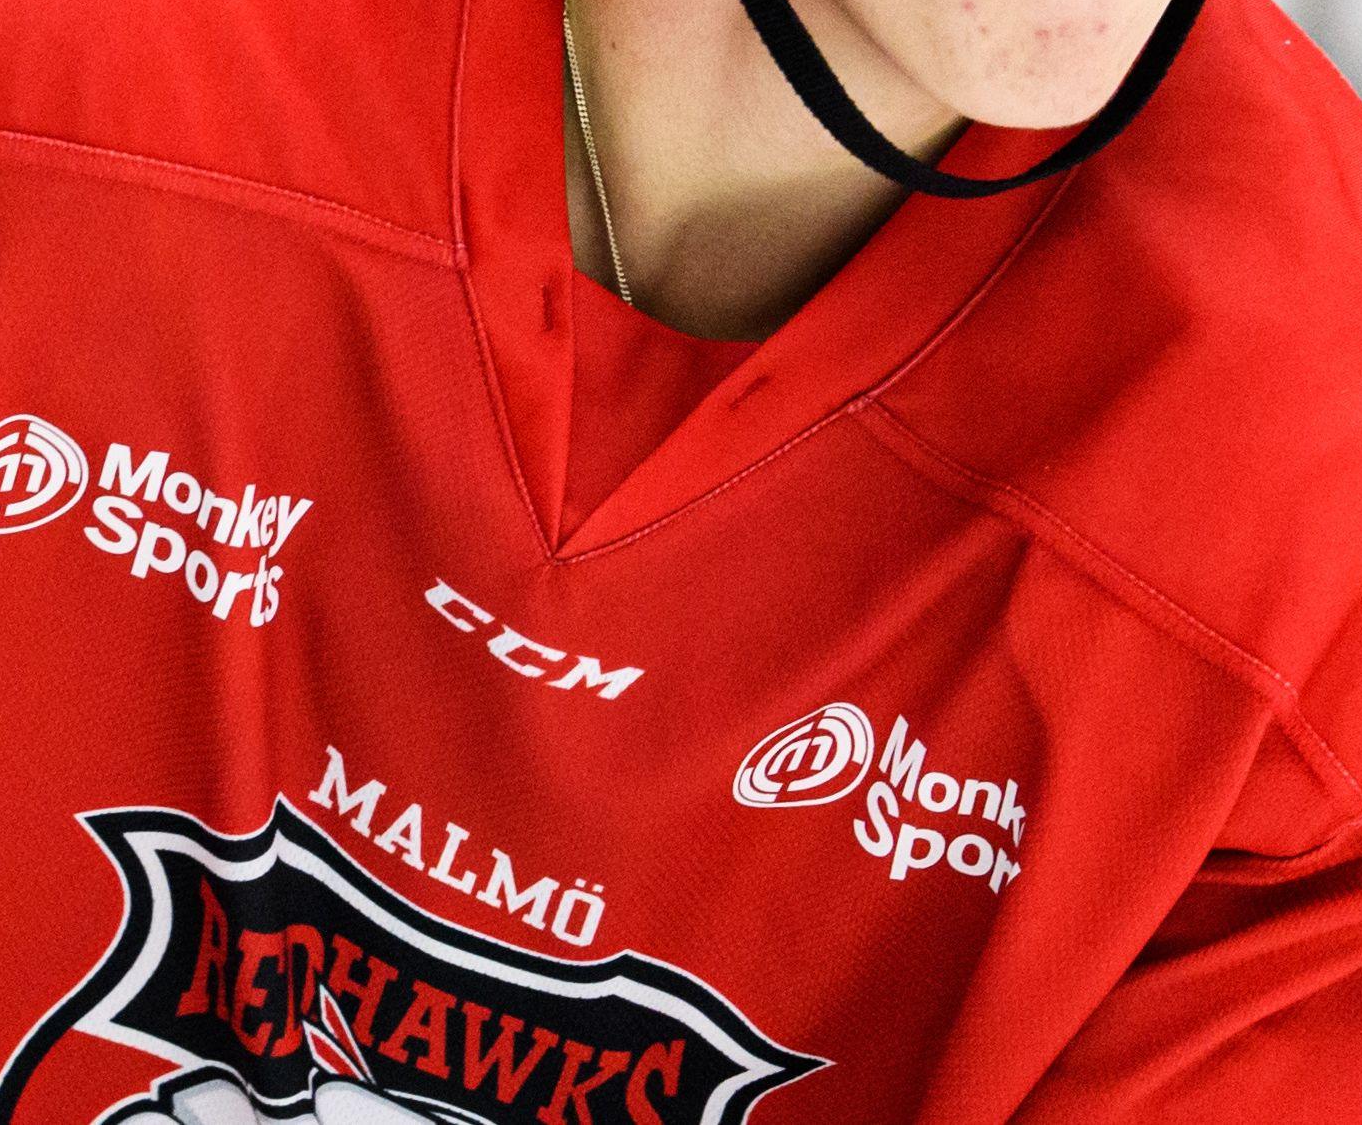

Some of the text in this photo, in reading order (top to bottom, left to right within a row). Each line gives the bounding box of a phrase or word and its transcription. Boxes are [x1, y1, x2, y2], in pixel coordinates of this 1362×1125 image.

[83, 495, 284, 629] Sports
[97, 442, 314, 557] Monkey
[423, 576, 646, 702] CCM
[307, 743, 610, 948] MALMÖ
[852, 780, 1022, 896] Spor
[878, 713, 1027, 849] Monk
[175, 874, 687, 1125] REDHAWKS
